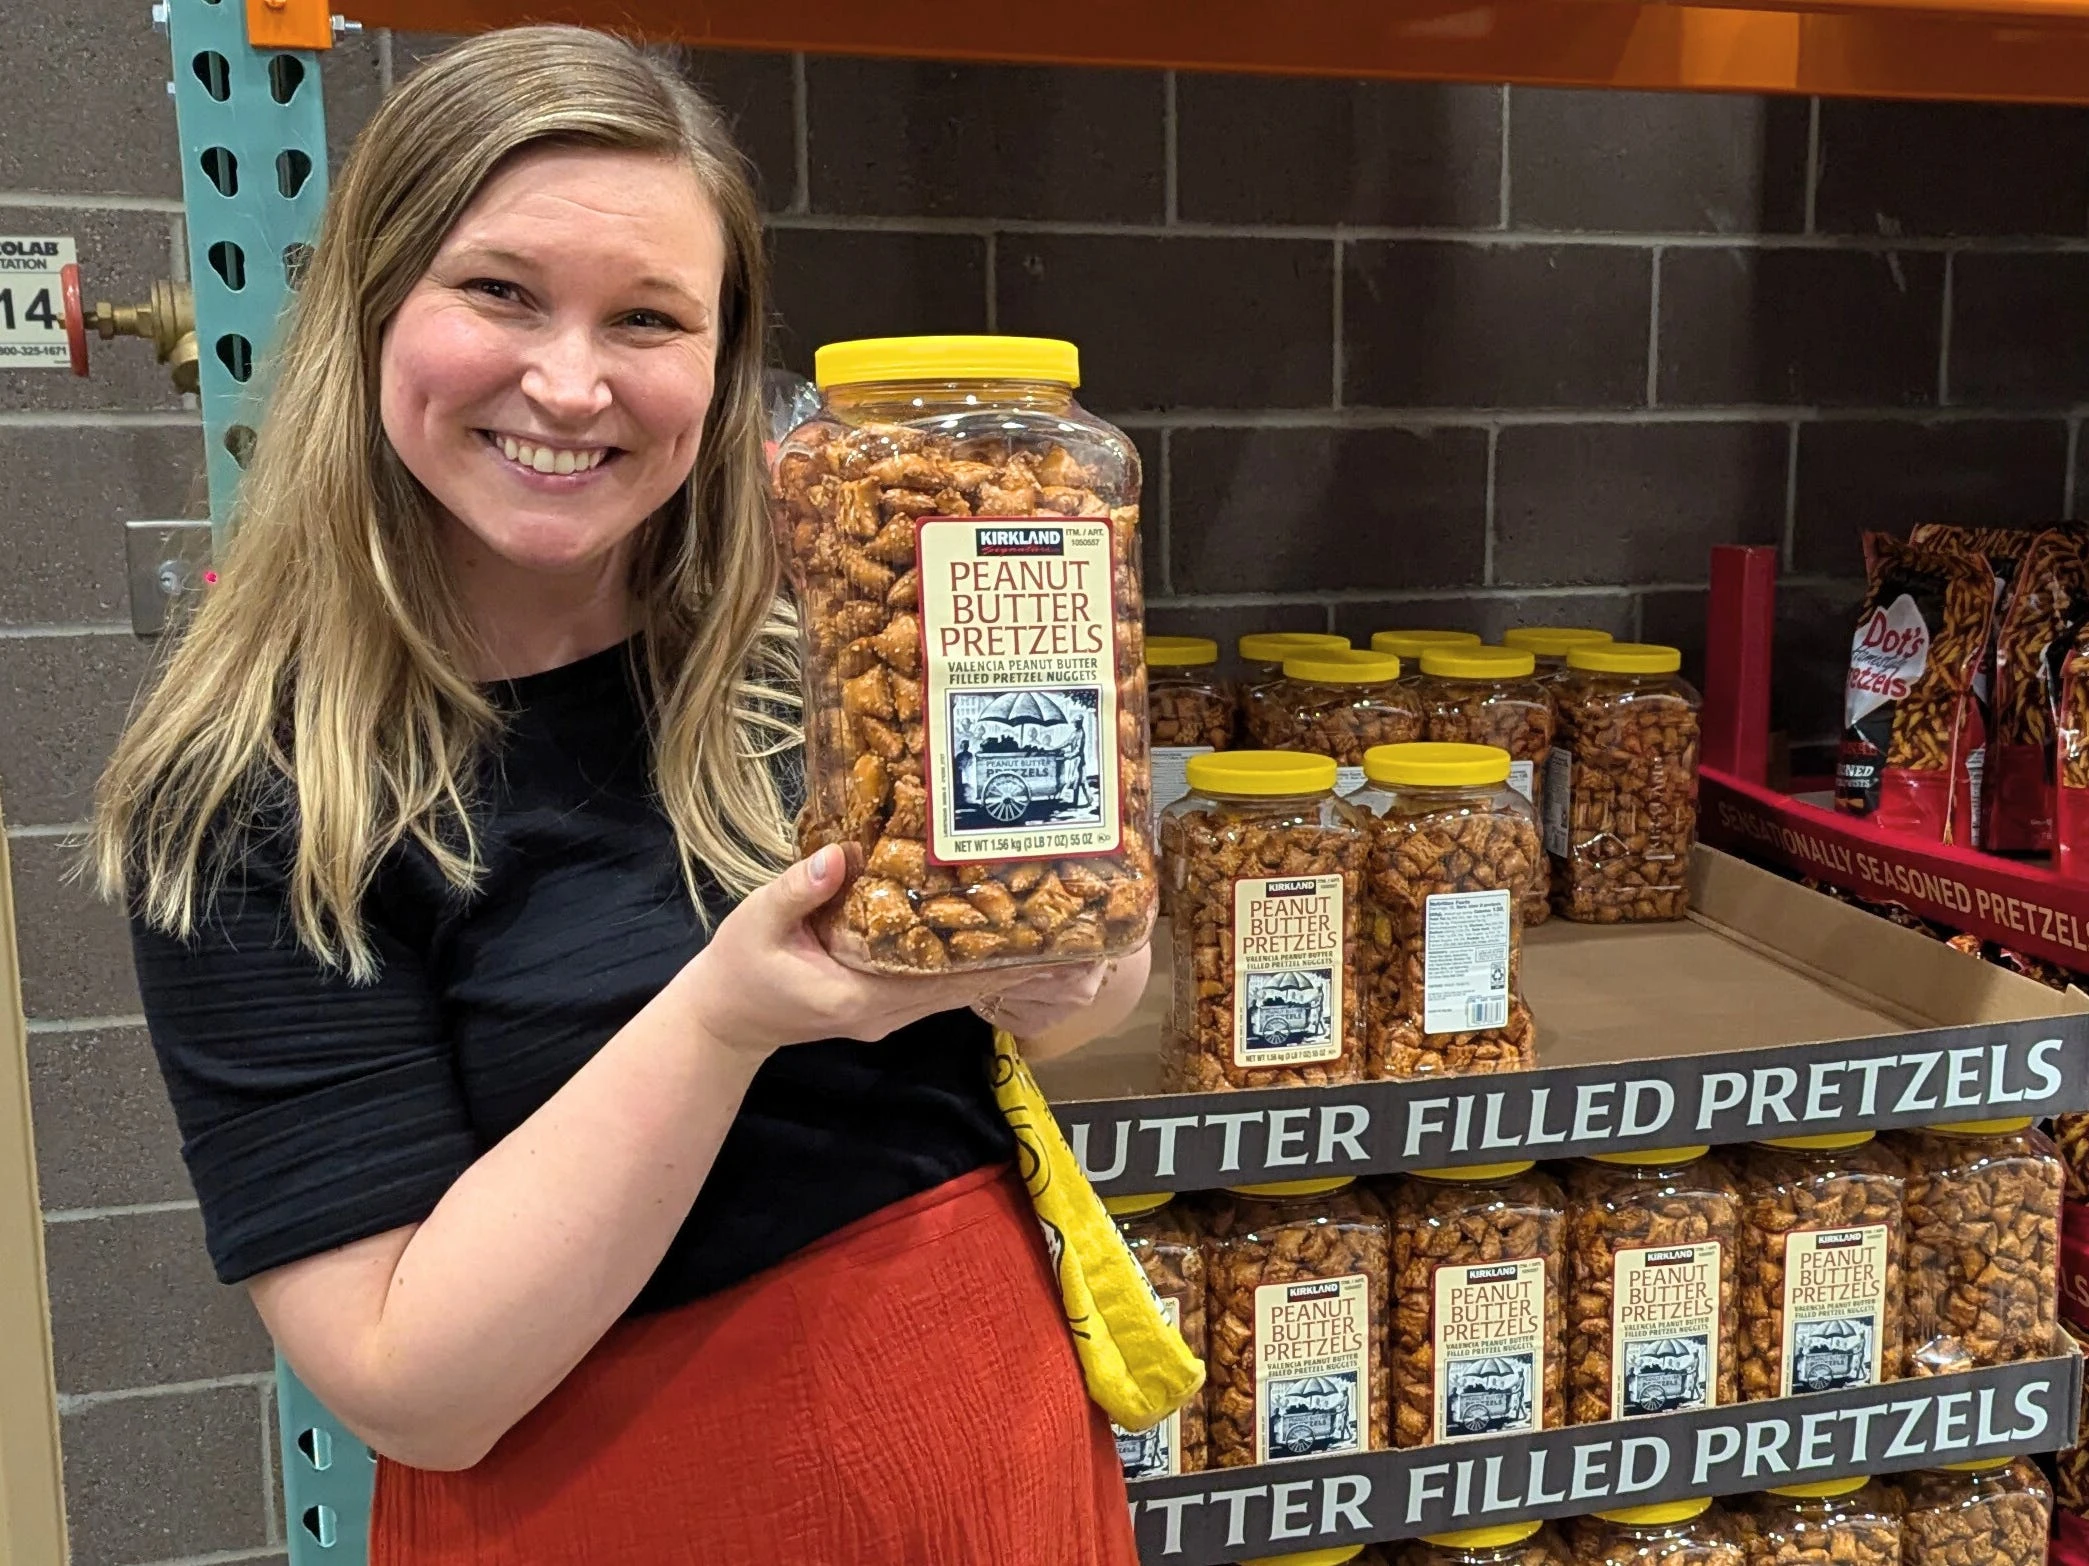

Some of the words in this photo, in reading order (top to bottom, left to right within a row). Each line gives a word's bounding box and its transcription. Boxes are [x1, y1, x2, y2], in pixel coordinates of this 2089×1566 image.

[0, 241, 59, 256] OLAB
[981, 531, 1061, 545] KIRKLAND
[950, 561, 1089, 592] PEANUT
[953, 593, 1091, 624] BUTTER
[940, 624, 1103, 657] PRETZELS
[1862, 610, 1924, 658] Dot's
[948, 661, 1004, 673] VALENCIA
[1010, 659, 1052, 671] PEANUT
[1057, 658, 1097, 669] BUTTER
[950, 672, 989, 685] FILLED
[993, 671, 1043, 683] PRETZEL
[1047, 670, 1097, 682] NUGGETS
[955, 841, 971, 852] NET
[974, 841, 988, 851] WT
[991, 839, 1009, 850] 1.56
[1011, 839, 1022, 851] kg
[1034, 837, 1045, 848] LB
[1070, 834, 1081, 846] 55
[1082, 833, 1093, 844] OZ
[1269, 881, 1314, 892] KIRKLAND
[1719, 803, 1856, 876] SENSATIONALLY
[1856, 854, 1972, 915] SEASONED
[1976, 887, 2089, 952] PRETZEL
[1250, 896, 1331, 918] PEANUT
[1251, 915, 1330, 935] BUTTER
[1243, 932, 1337, 954] PRETZELS
[1071, 1104, 1371, 1182] UTTER
[1402, 1079, 1675, 1157] FILLED
[1695, 1039, 2063, 1130] PRETZELS
[1647, 1250, 1693, 1261] KIRKLAND
[1800, 1247, 1876, 1269] PEANUT
[1469, 1268, 1515, 1279] KIRKLAND
[1629, 1264, 1708, 1287] PEANUT
[1800, 1264, 1874, 1286] BUTTER
[1290, 1284, 1338, 1297] KIRKLAND
[1451, 1281, 1532, 1305] PEANUT
[1629, 1282, 1707, 1304] BUTTER
[1792, 1280, 1880, 1304] PRETZELS
[1271, 1297, 1356, 1324] PEANUT
[1451, 1299, 1532, 1323] BUTTER
[1621, 1298, 1713, 1322] PRETZELS
[1272, 1316, 1355, 1343] BUTTER
[1443, 1316, 1538, 1342] PRETZELS
[1264, 1333, 1362, 1361] PRETZELS
[1129, 1474, 1373, 1556] TTER
[1404, 1436, 1670, 1524] FILLED
[1691, 1381, 2050, 1485] PRETZELS
